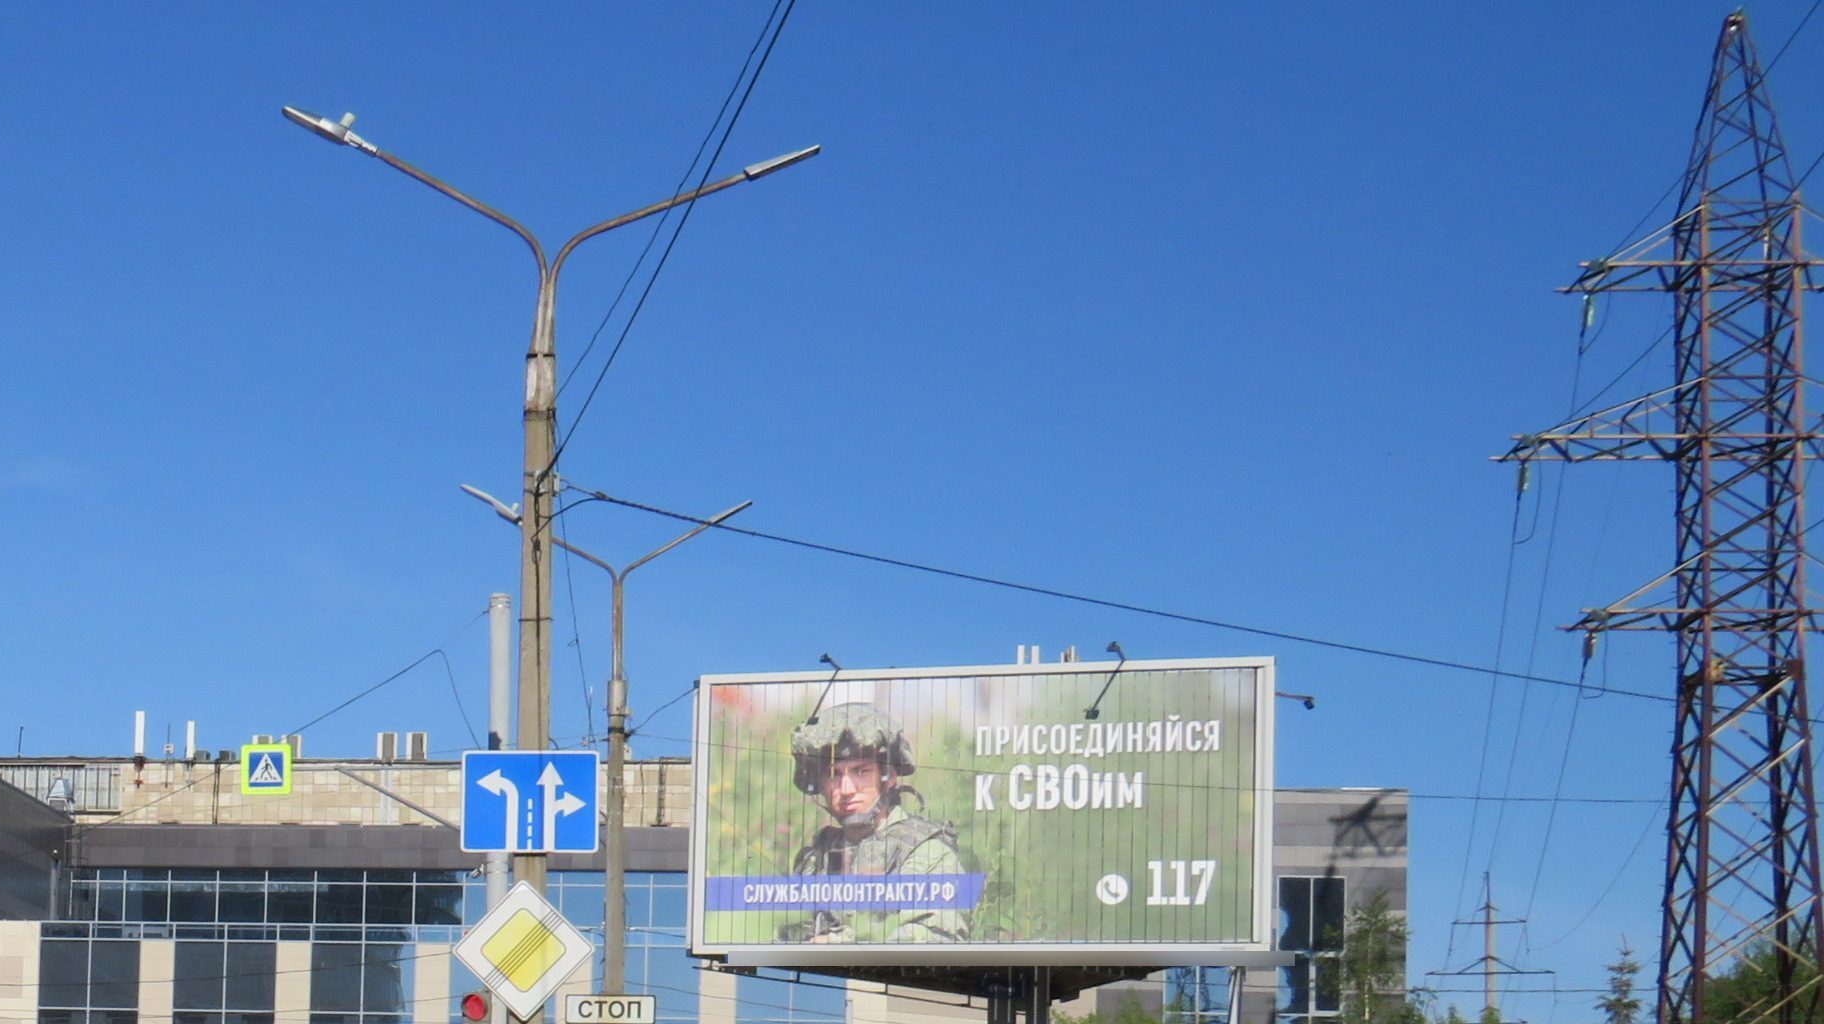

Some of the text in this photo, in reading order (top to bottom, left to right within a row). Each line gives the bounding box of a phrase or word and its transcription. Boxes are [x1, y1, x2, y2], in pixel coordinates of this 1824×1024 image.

[975, 715, 1221, 758] ПРИСОЕДИНЯЙСЯ
[743, 881, 956, 904] СЛУЖБАПОКОНТРАКТУ.РФ
[1146, 860, 1217, 906] 117
[577, 1000, 642, 1019] СТОП
